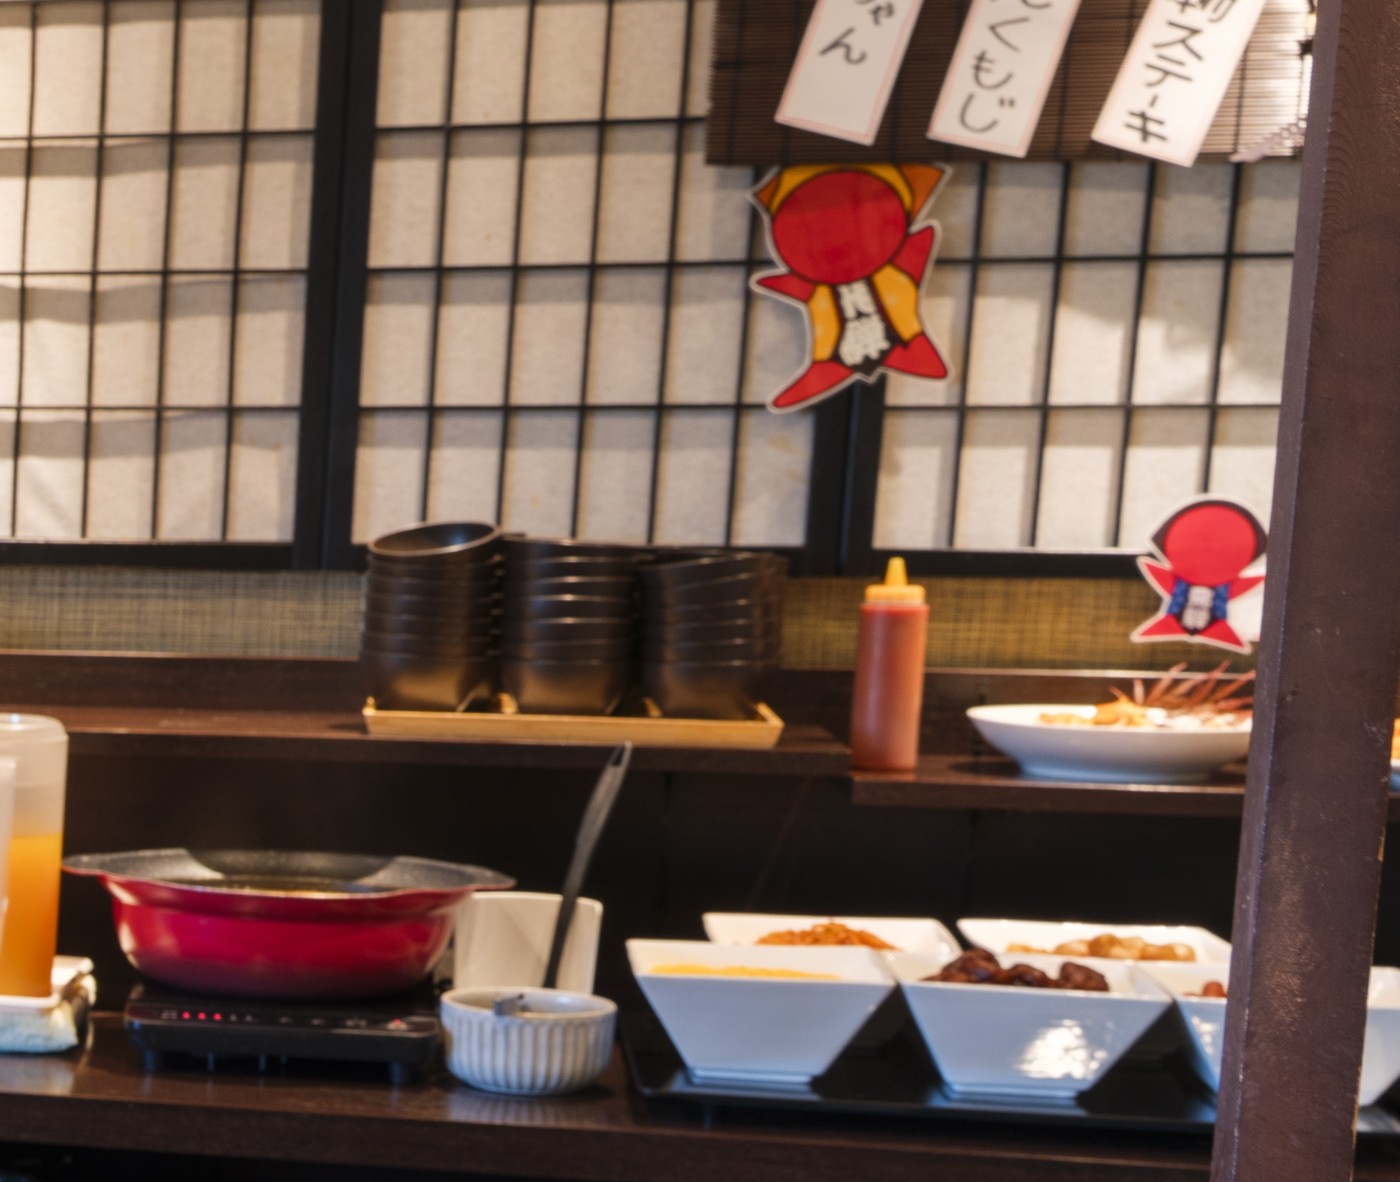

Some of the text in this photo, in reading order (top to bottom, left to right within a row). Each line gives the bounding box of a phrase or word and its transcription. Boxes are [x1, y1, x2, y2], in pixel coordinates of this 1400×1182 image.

[819, 0, 894, 65] ゃん
[959, 0, 1052, 132] くもじ
